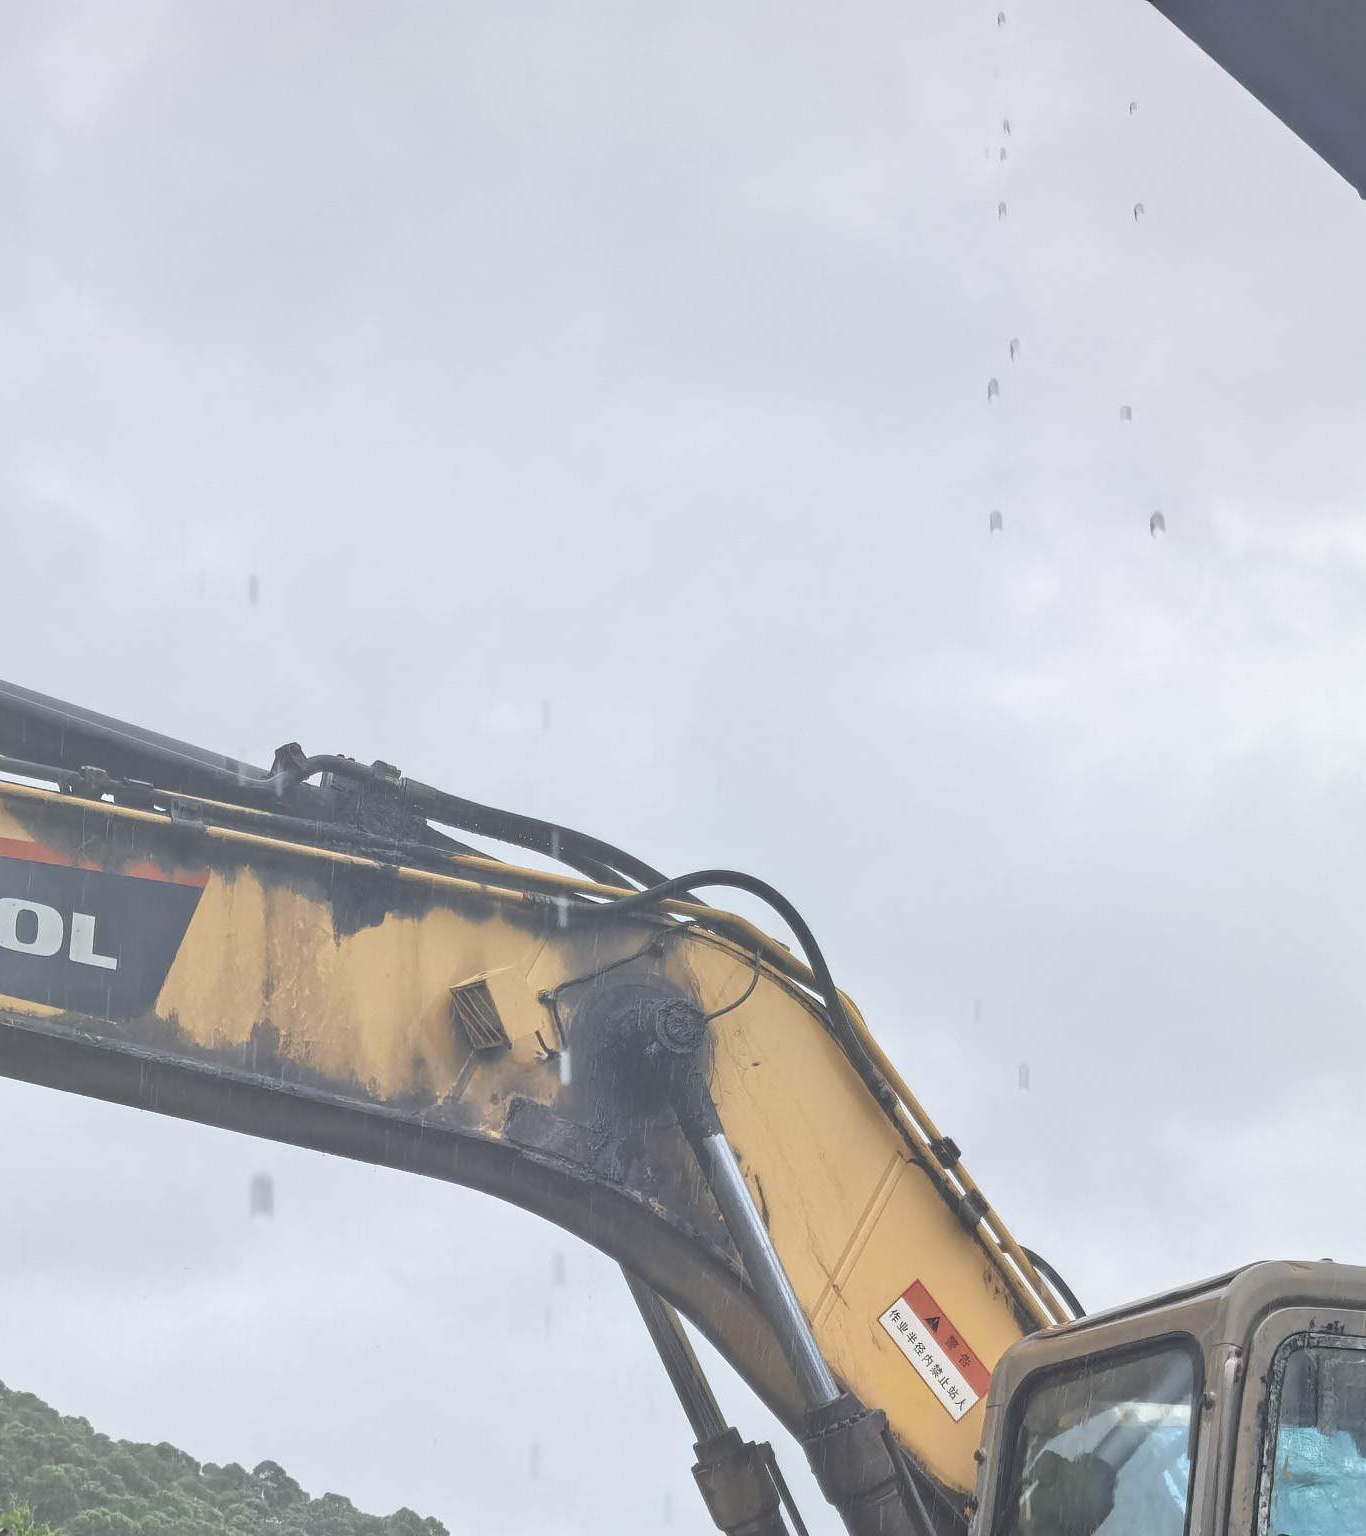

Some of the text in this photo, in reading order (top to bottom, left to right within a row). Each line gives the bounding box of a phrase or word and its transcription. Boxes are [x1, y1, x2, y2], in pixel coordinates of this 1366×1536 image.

[888, 1308, 969, 1412] 作业半径内禁止站人
